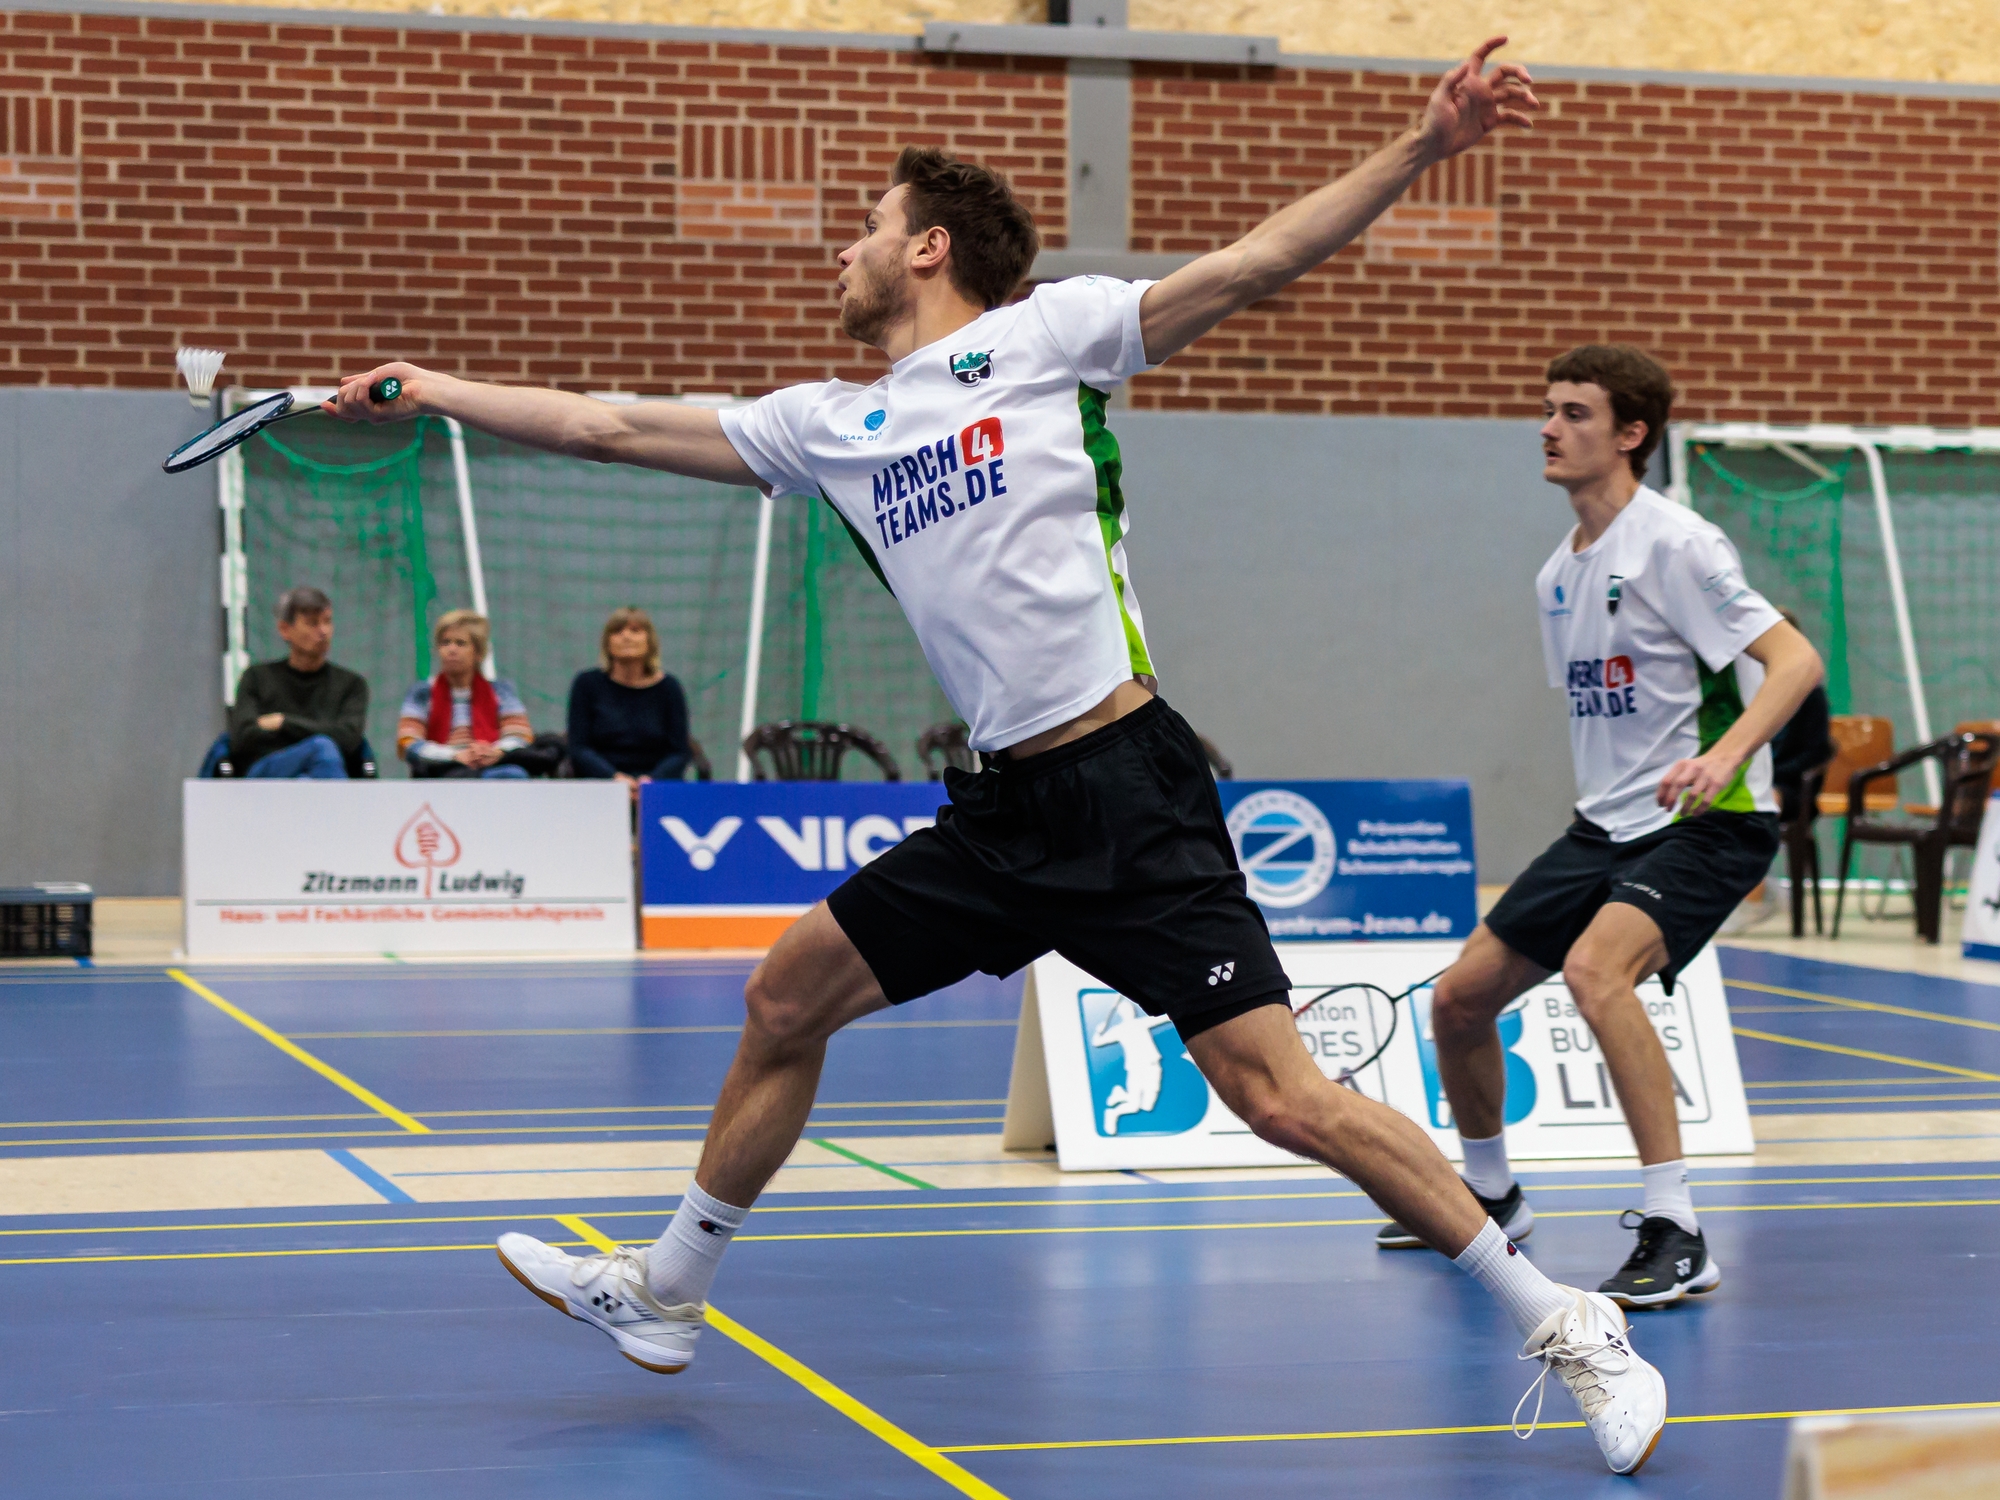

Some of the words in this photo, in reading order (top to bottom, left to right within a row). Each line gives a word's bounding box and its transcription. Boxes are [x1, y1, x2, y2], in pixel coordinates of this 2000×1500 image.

[872, 434, 958, 512] MERCH
[875, 458, 1007, 550] TEAMS.DE
[757, 814, 938, 872] VIC
[302, 872, 419, 893] Zitzmann
[439, 870, 525, 898] Ludwig
[275, 907, 309, 923] und
[1269, 911, 1453, 936] entrum-Jena.de
[1298, 1030, 1364, 1057] DES
[1550, 1026, 1683, 1053] BUS
